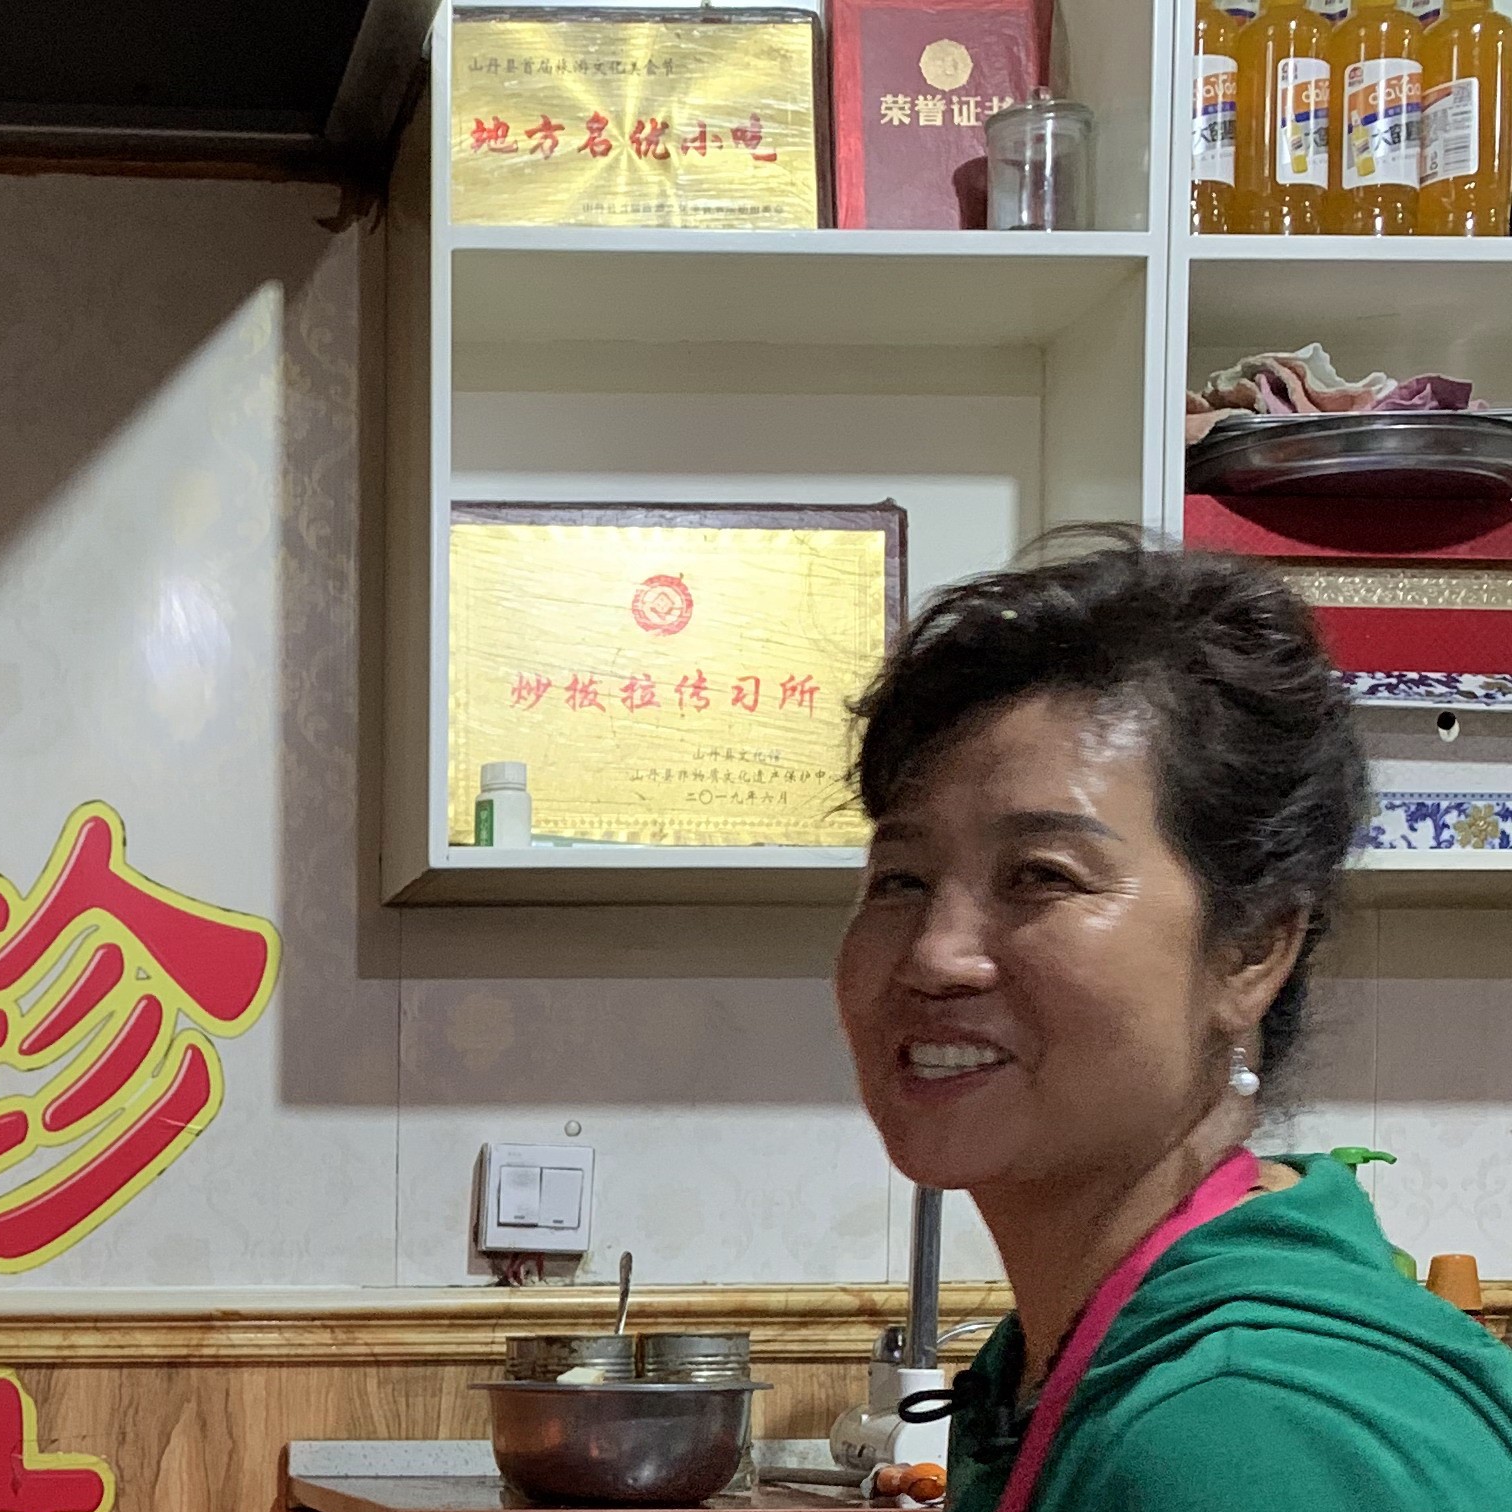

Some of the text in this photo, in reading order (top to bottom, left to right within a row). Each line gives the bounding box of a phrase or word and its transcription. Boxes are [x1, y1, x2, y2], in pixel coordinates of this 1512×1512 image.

[470, 110, 779, 163] 地方名优小吃
[509, 669, 821, 718] 炒拨拉传习所
